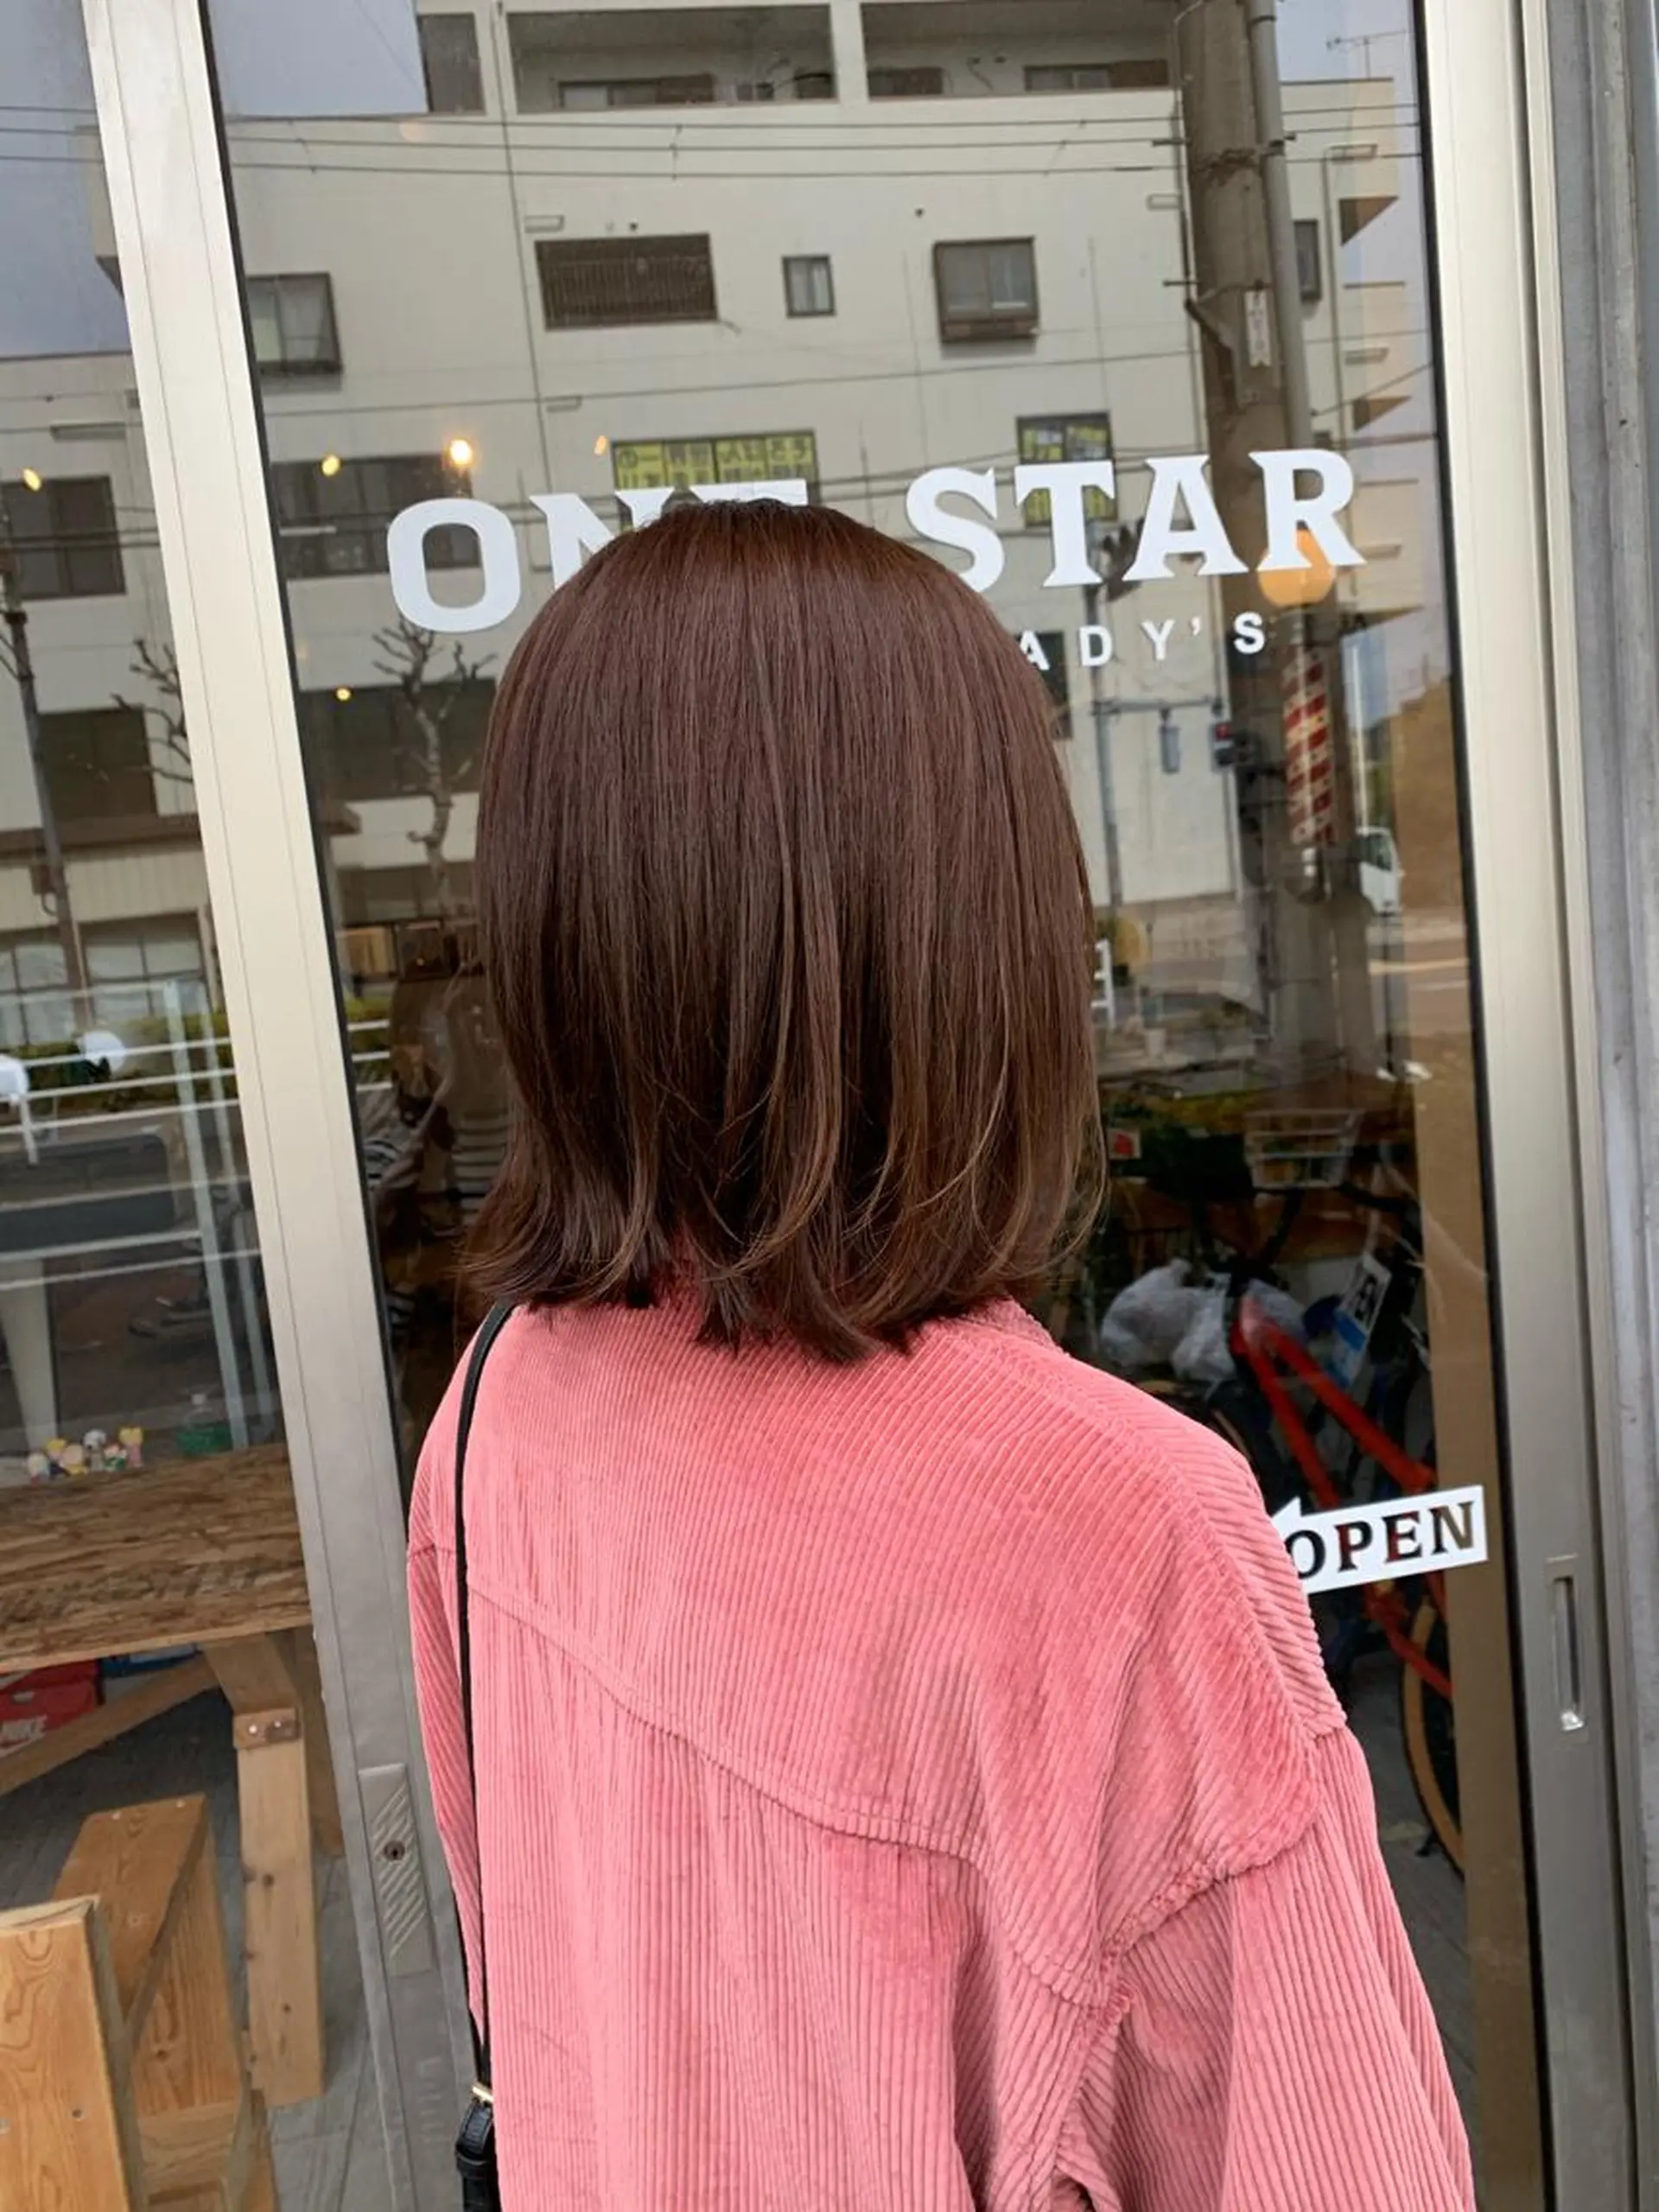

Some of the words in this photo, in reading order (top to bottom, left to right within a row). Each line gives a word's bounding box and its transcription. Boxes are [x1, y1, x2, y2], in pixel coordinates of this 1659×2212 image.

[386, 479, 808, 633] ON
[906, 448, 1368, 593] STAR
[1284, 1500, 1475, 1580] OPEN
